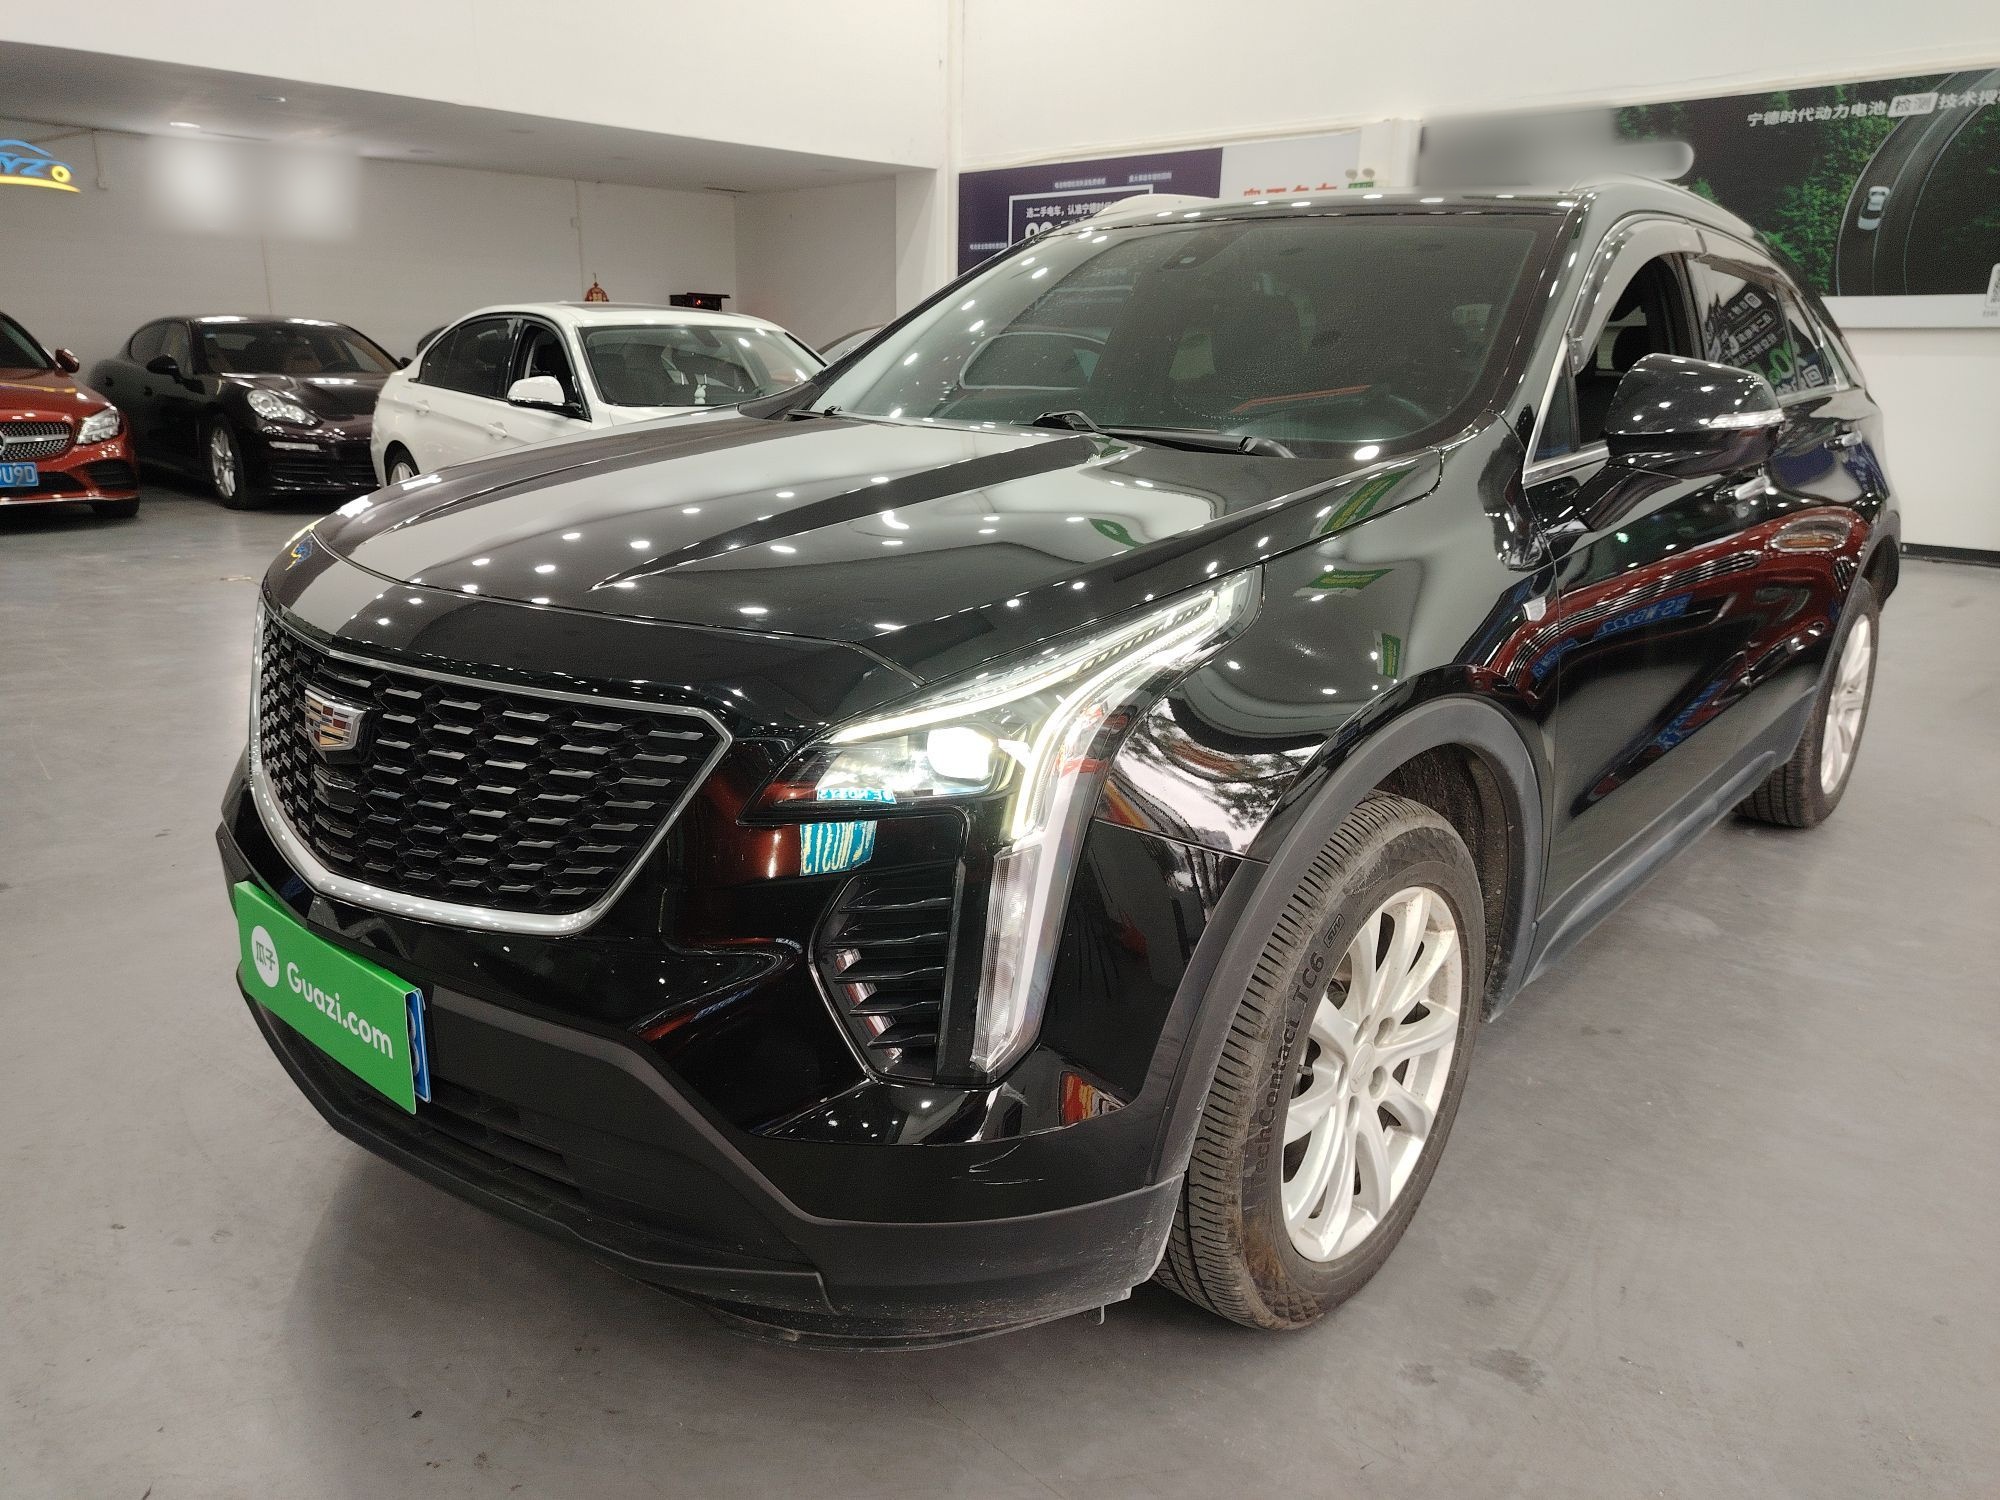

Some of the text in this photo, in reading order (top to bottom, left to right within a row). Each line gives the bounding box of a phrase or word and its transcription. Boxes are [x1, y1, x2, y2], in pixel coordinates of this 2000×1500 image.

[0, 466, 36, 485] U9D
[255, 941, 276, 971] 瓜子
[286, 961, 394, 1060] Guazi.com
